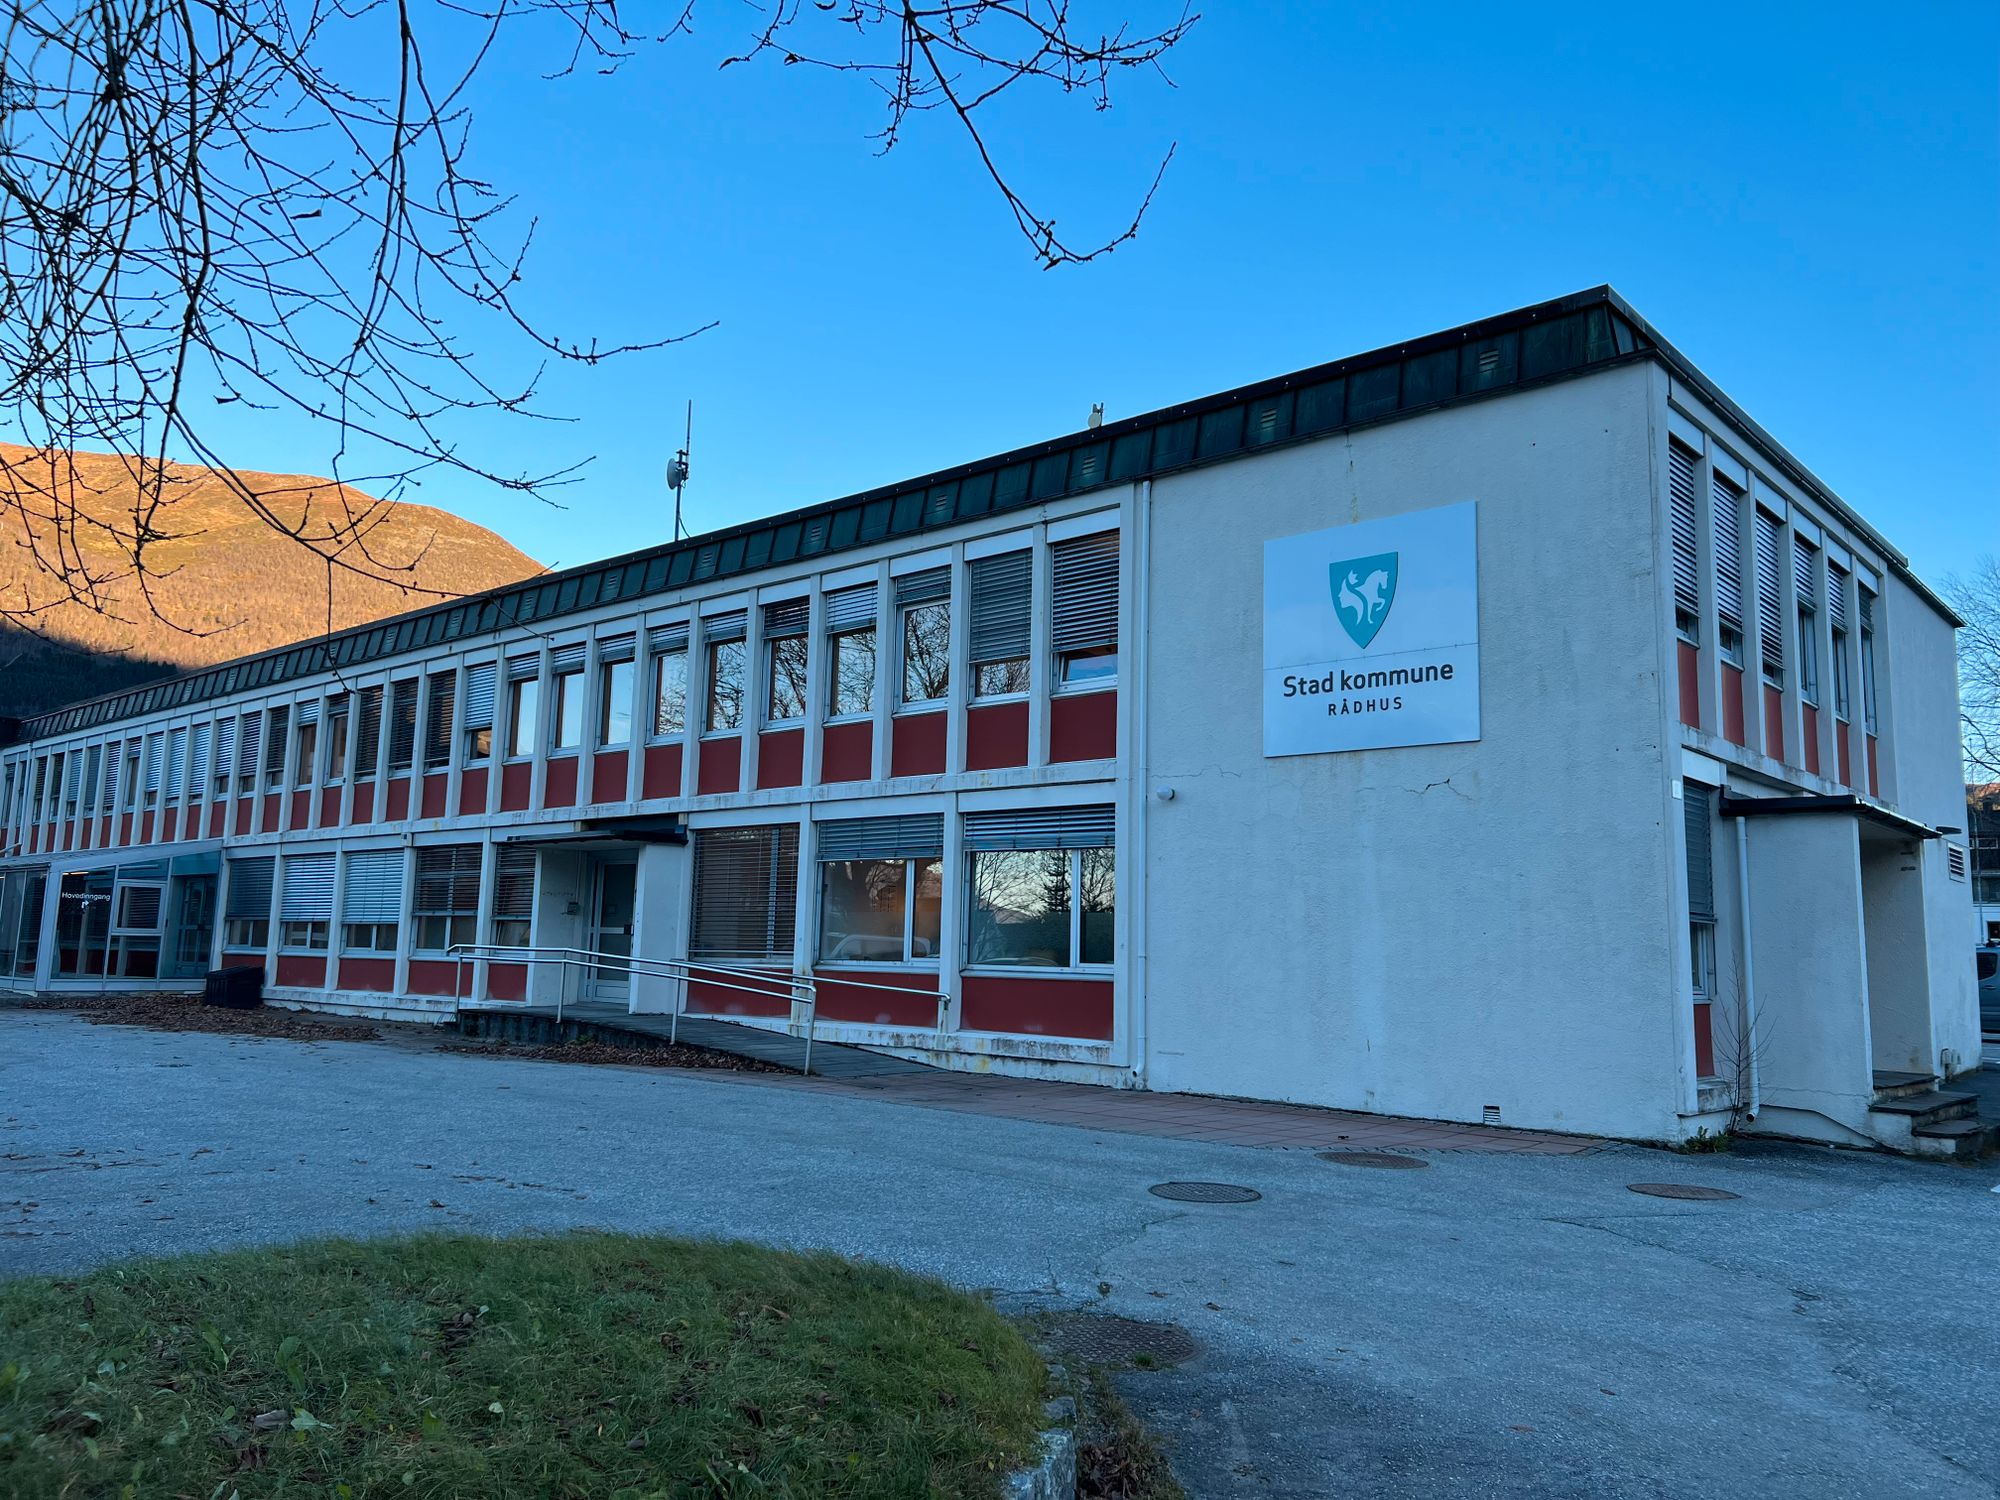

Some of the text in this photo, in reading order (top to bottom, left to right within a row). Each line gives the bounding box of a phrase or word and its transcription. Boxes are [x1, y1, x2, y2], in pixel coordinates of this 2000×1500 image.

[1283, 663, 1453, 697] Stad kommune
[1328, 697, 1402, 716] RÅDHUS
[62, 892, 111, 901] Hovedinngang
